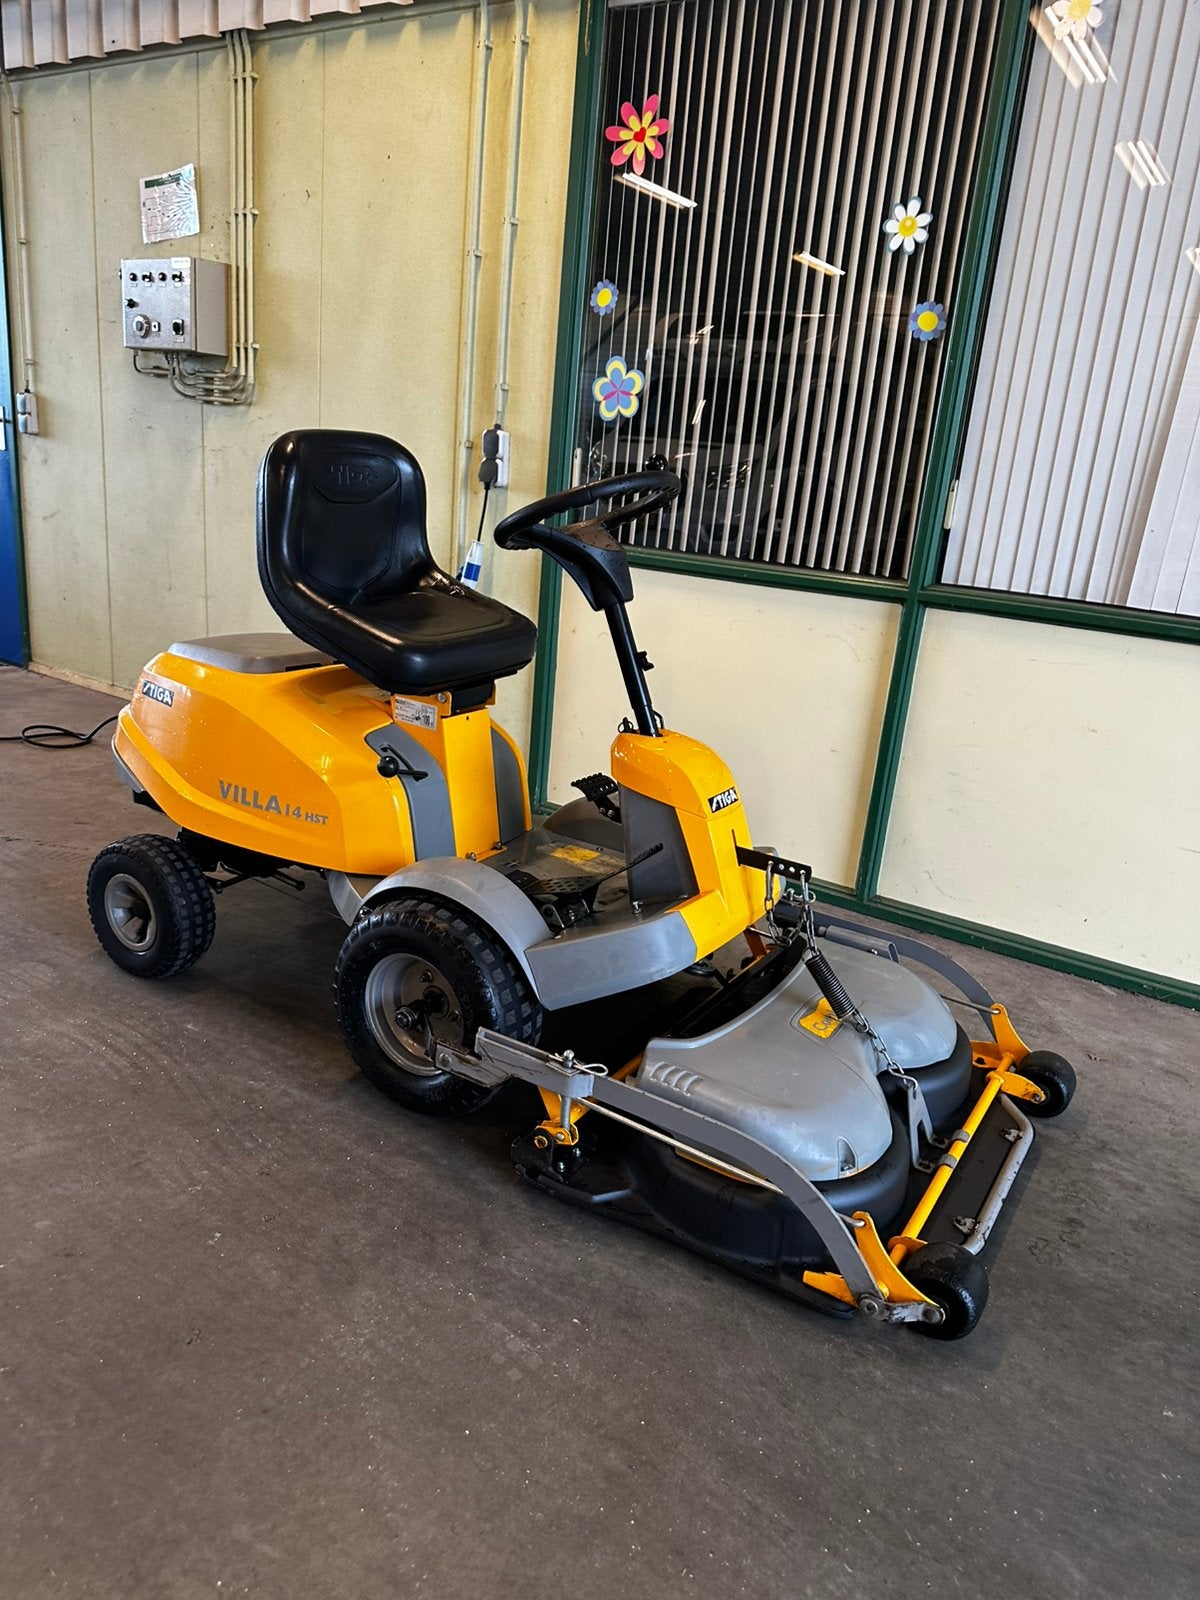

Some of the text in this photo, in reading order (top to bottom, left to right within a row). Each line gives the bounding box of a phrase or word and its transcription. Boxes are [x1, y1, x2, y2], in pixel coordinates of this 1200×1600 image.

[143, 681, 172, 706] STIGA
[219, 780, 328, 825] VILLA 14 HST
[711, 788, 738, 812] STIGA
